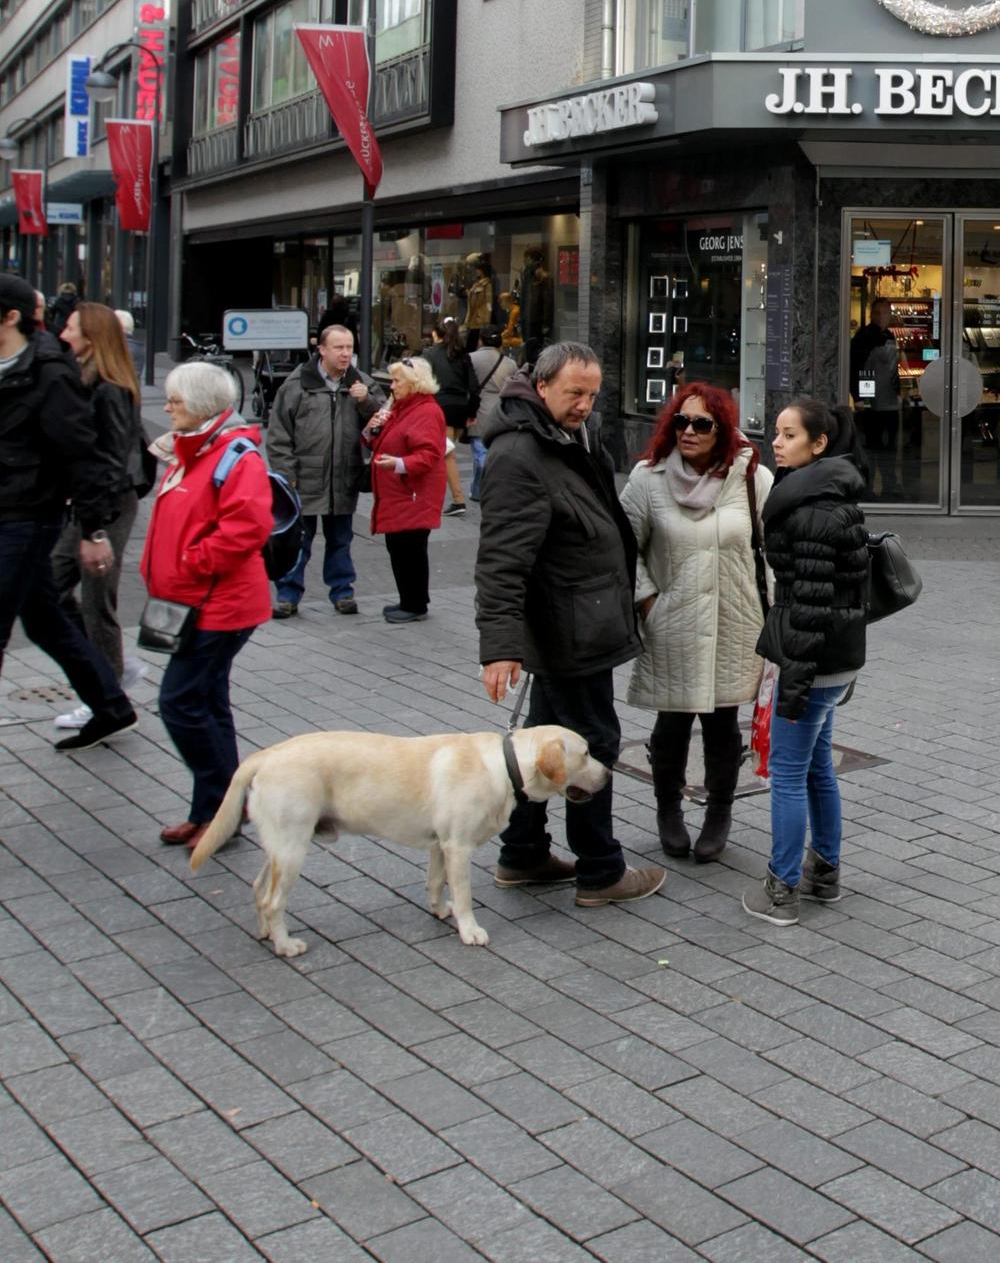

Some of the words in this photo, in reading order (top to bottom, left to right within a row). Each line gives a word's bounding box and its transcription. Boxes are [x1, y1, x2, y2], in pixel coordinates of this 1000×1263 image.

[139, 3, 165, 23] &
[135, 28, 165, 122] HADES
[765, 67, 863, 116] J.H.
[557, 82, 659, 141] BECKER
[699, 236, 725, 251] GEORG
[726, 235, 744, 252] JENS
